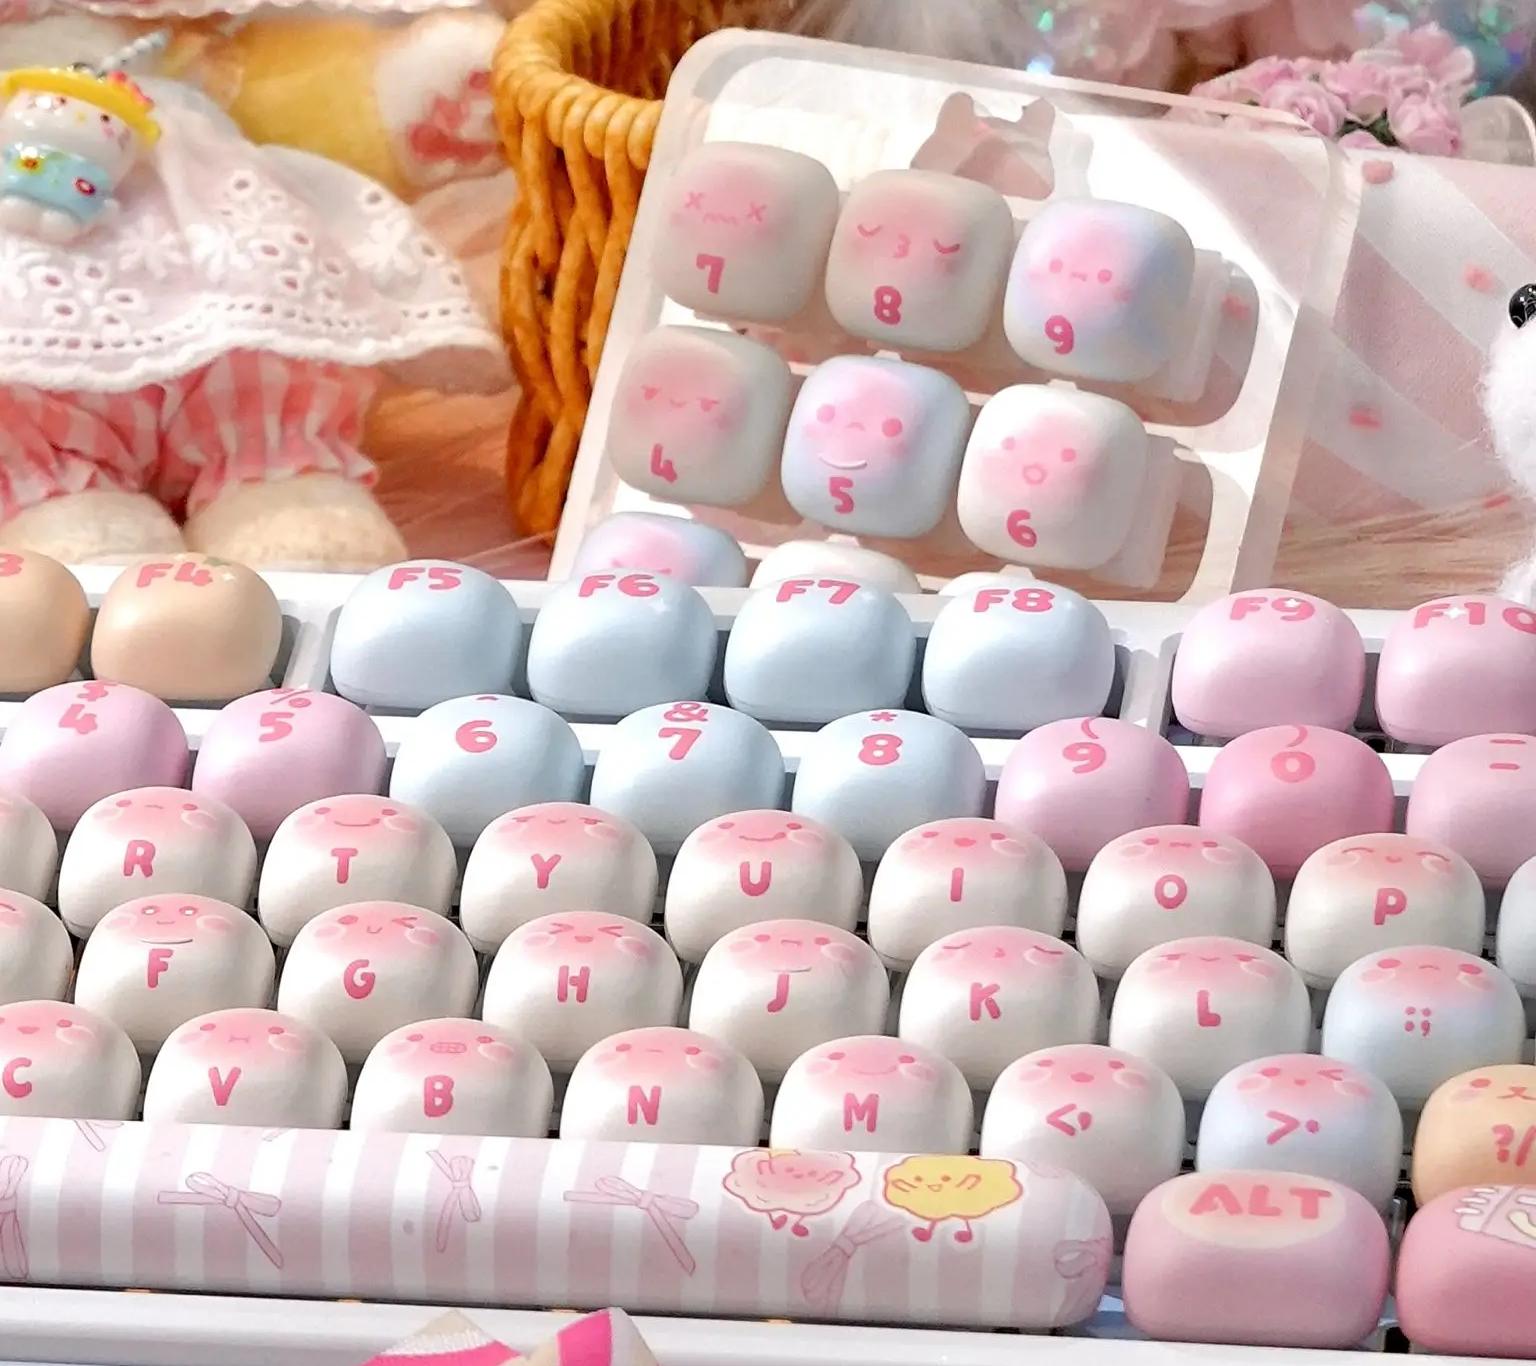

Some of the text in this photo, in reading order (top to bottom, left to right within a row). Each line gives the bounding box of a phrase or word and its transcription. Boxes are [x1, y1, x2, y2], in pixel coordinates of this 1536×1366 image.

[695, 254, 726, 295] 7
[873, 285, 903, 327] 8
[1043, 314, 1076, 356] 9
[650, 443, 678, 484] 4
[827, 477, 857, 515] 5
[1006, 509, 1038, 549] 6
[136, 561, 213, 588] F4
[387, 567, 463, 591] F5
[578, 574, 661, 598] F6
[776, 579, 862, 604] F7
[973, 588, 1054, 614] F8
[1229, 596, 1316, 622] F9
[77, 680, 118, 702] $
[270, 687, 312, 709] %
[58, 703, 98, 735] 4
[258, 711, 294, 742] 5
[663, 702, 708, 722] &
[456, 720, 497, 753] 6
[657, 727, 702, 761] 7
[858, 733, 904, 766] 8
[1062, 743, 1107, 774] 9
[123, 840, 156, 878] R
[331, 848, 358, 885] T
[530, 854, 562, 889] Y
[739, 861, 772, 897] U
[950, 867, 965, 902] I
[1154, 874, 1188, 910] O
[1373, 886, 1407, 927] P
[146, 949, 174, 989] F
[343, 959, 376, 1000] G
[556, 965, 591, 1003] H
[767, 974, 790, 1013] J
[969, 982, 1001, 1022] K
[1196, 989, 1222, 1027] L
[1, 1057, 33, 1098] C
[208, 1066, 242, 1107] V
[422, 1075, 455, 1118] B
[627, 1085, 662, 1126] N
[843, 1093, 880, 1133] M
[1188, 1183, 1333, 1221] ALT
